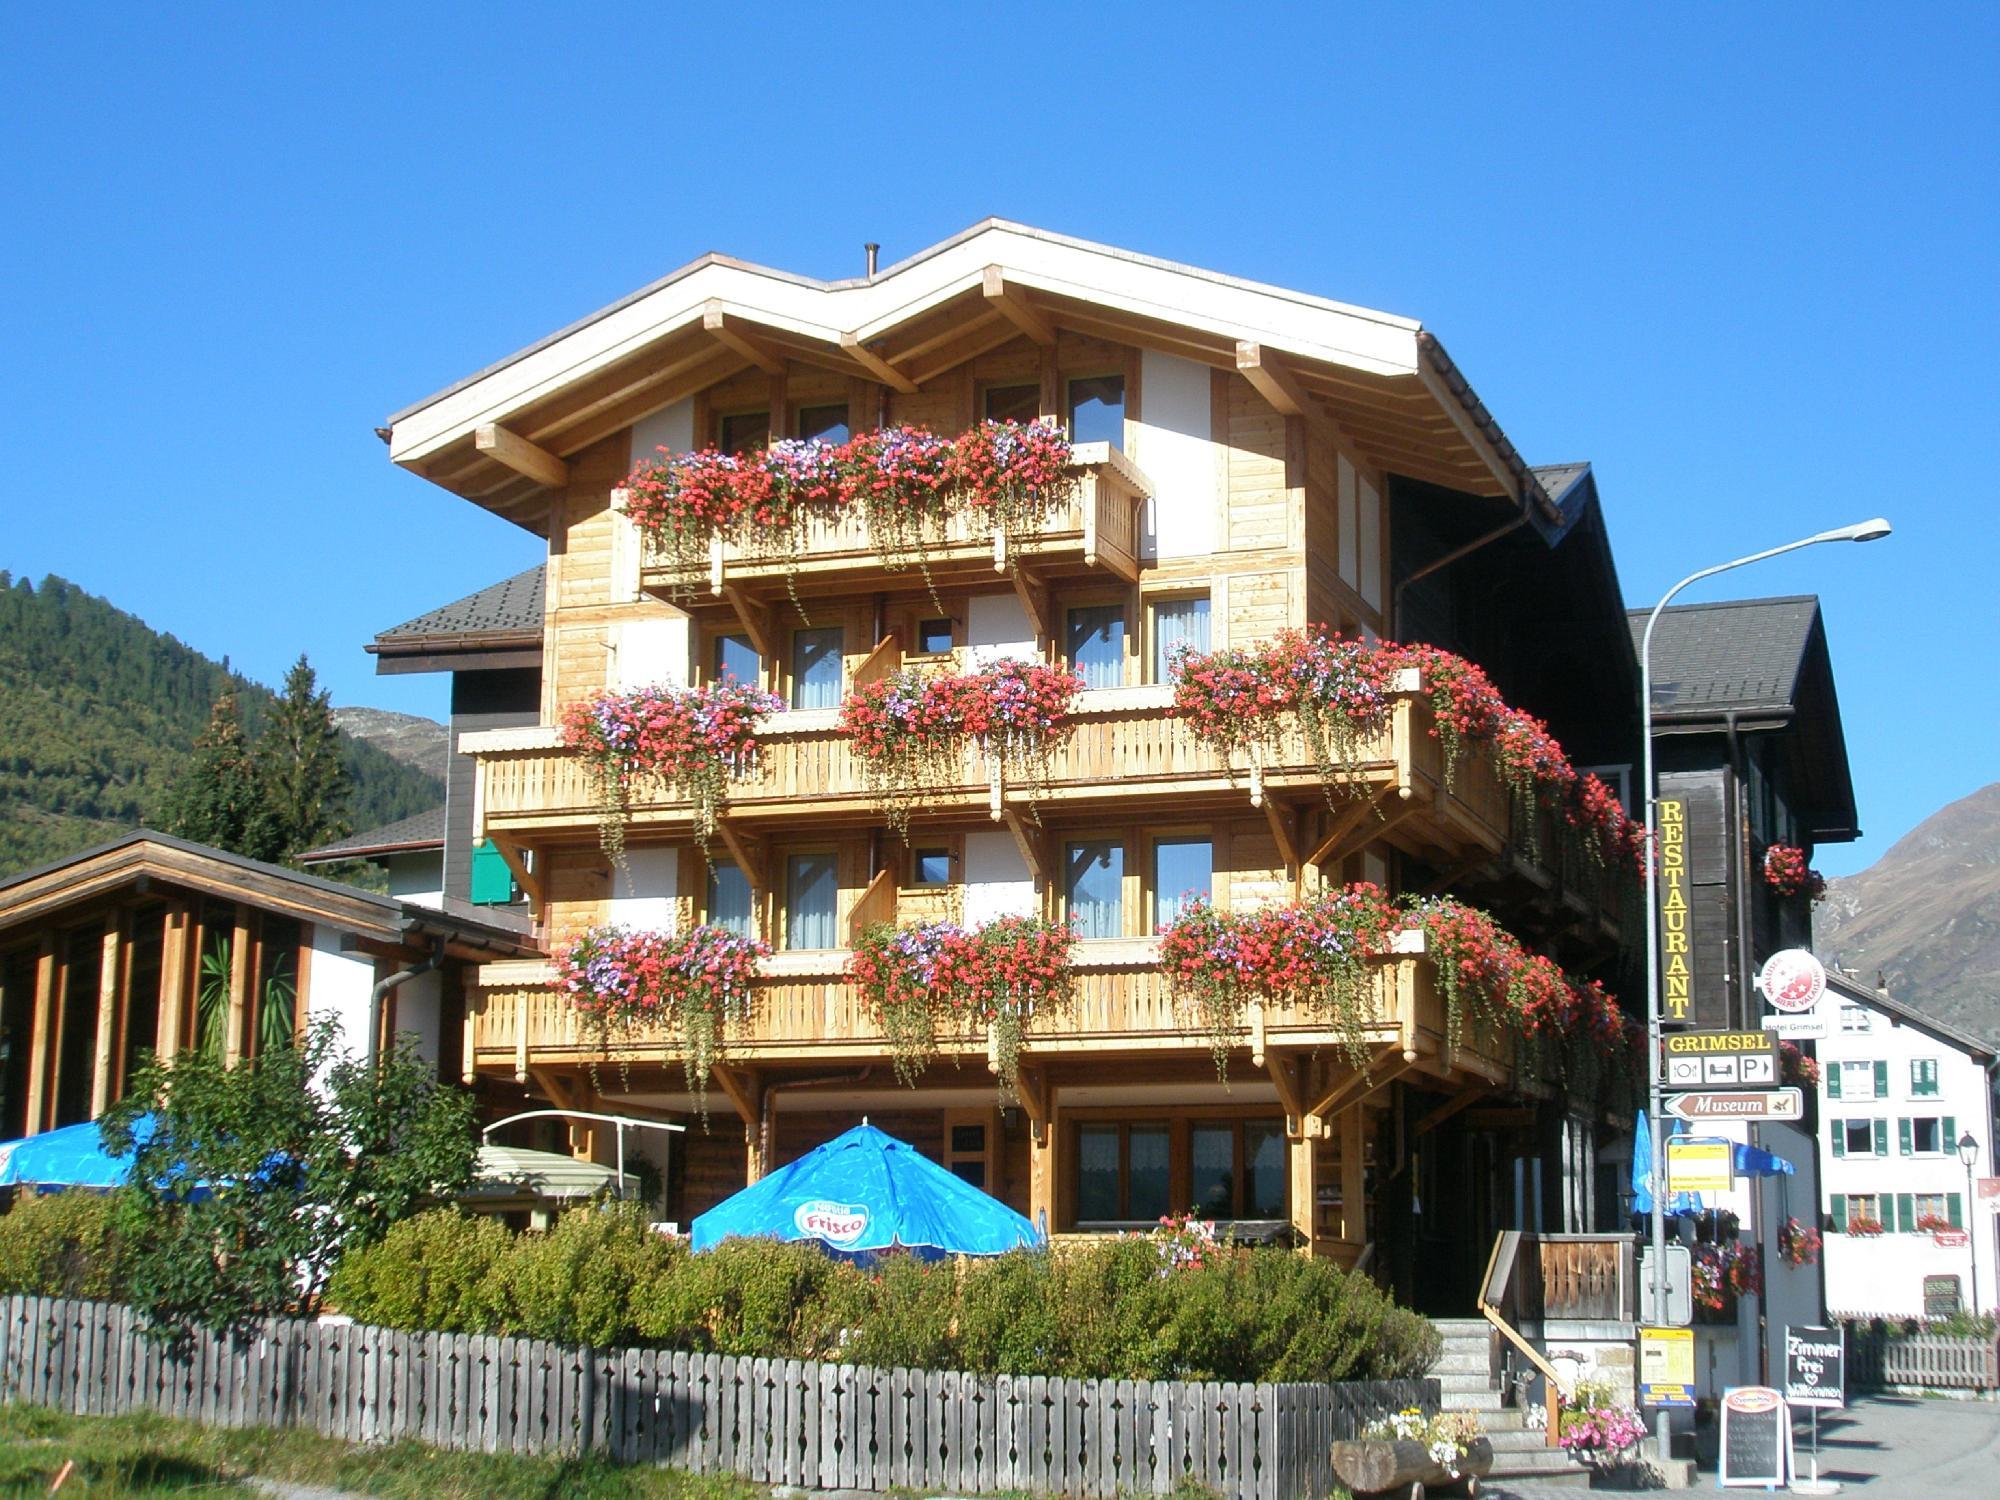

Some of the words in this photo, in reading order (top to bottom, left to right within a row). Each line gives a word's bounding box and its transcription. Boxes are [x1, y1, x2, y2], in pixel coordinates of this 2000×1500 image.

[1660, 801, 1689, 1018] RESTAURANT
[1789, 1023, 1823, 1031] Grimsel
[1669, 1034, 1771, 1052] GRIMSEL
[1744, 1059, 1757, 1079] P
[1694, 1096, 1763, 1113] Museum
[807, 1215, 862, 1234] Frisco
[1788, 1337, 1842, 1358] Zimmer
